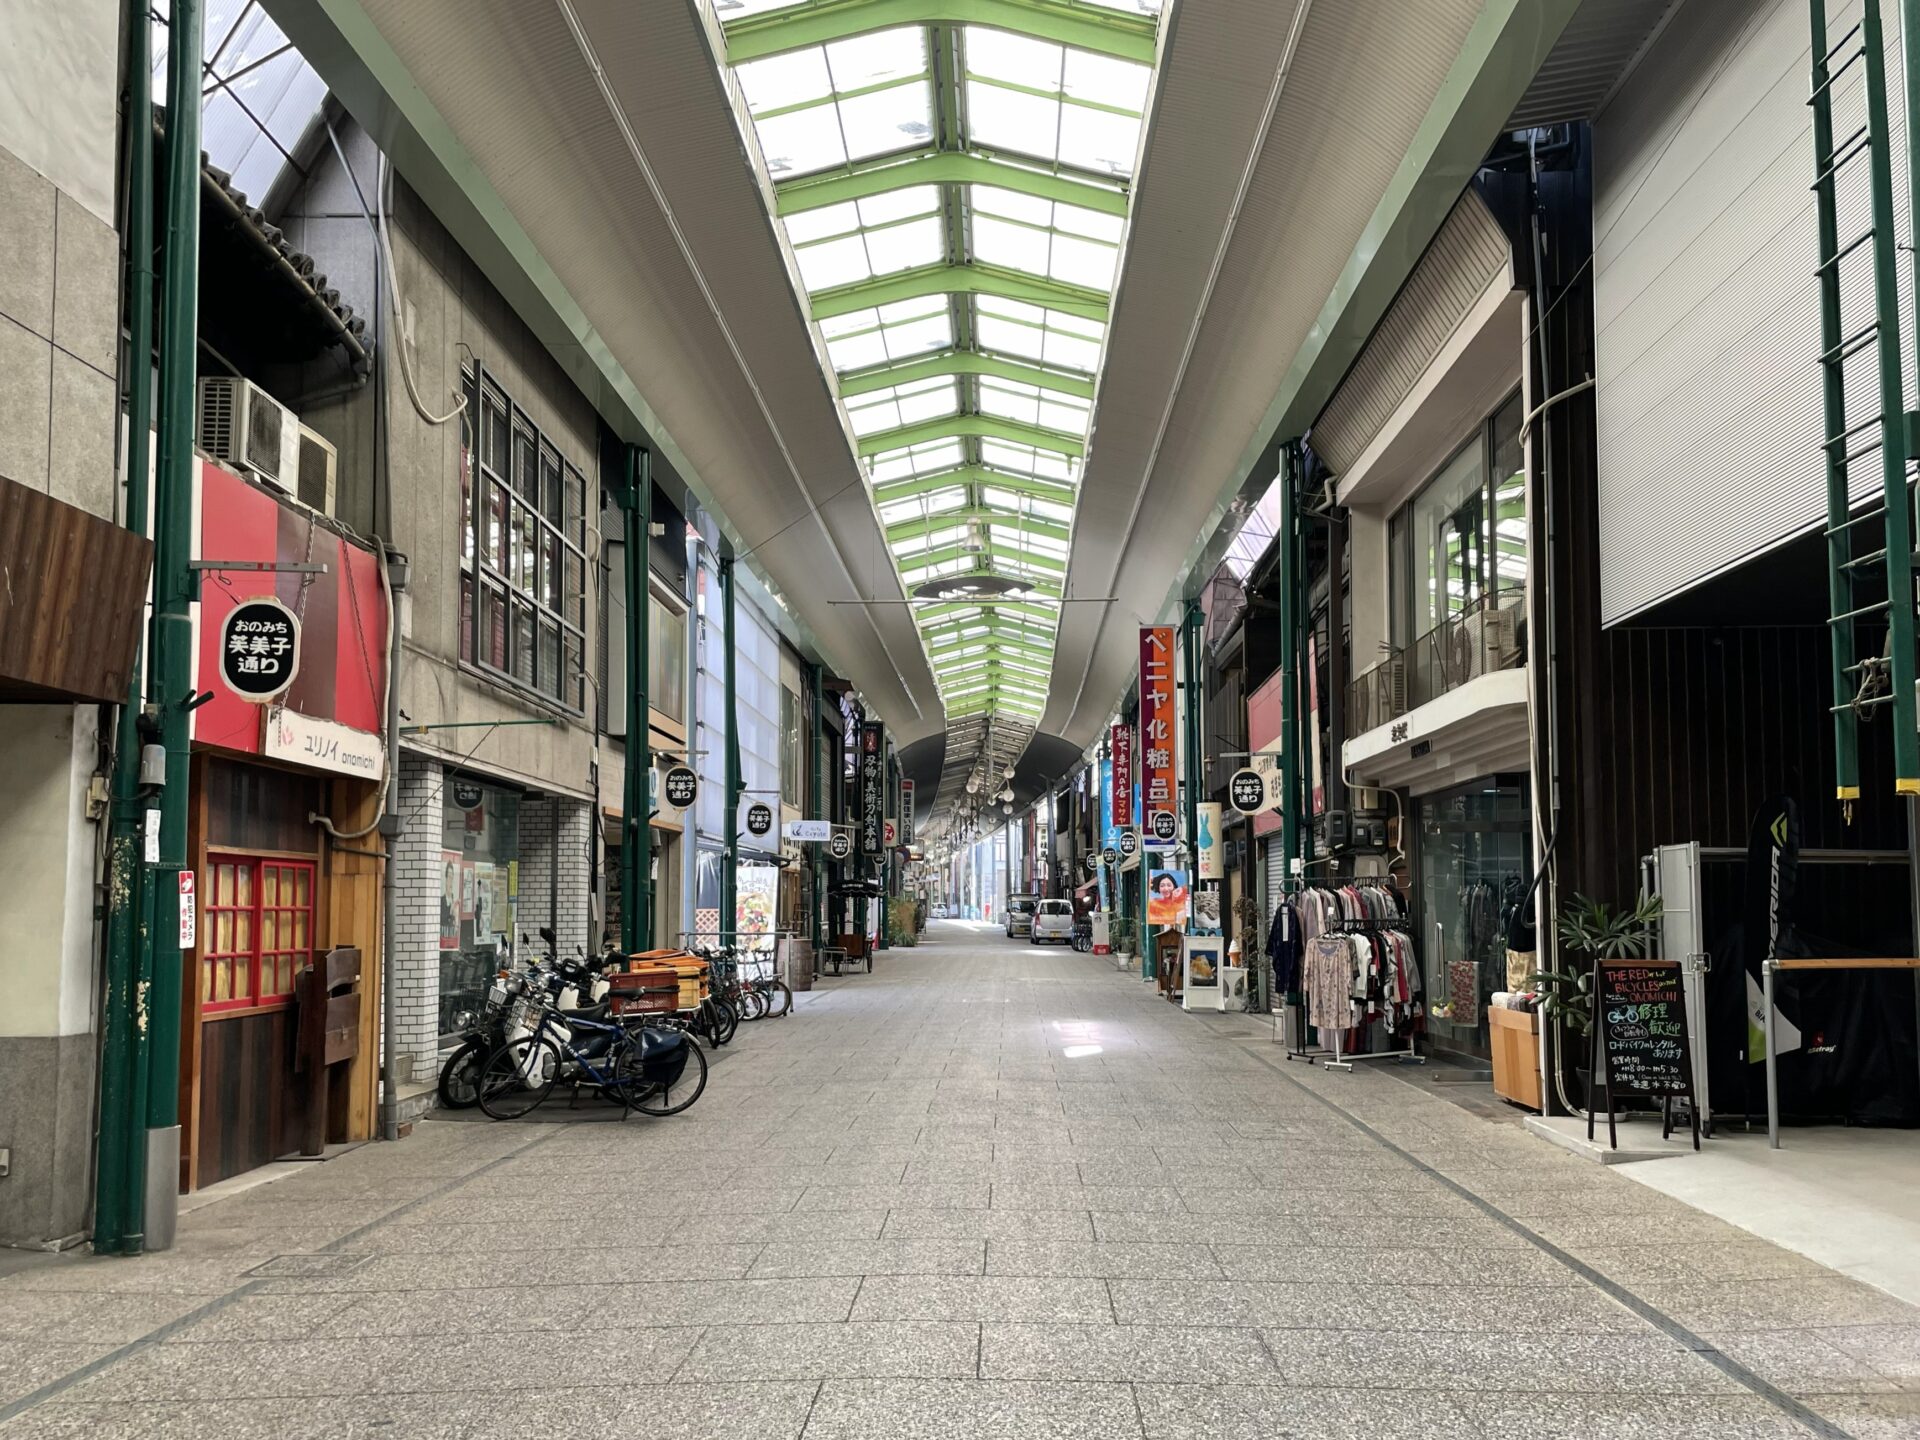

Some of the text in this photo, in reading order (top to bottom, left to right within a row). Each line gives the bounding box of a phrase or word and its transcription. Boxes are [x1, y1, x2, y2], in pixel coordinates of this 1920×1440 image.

[234, 620, 288, 634] おのみち
[228, 634, 292, 656] 芙美子
[237, 656, 280, 674] 通り
[304, 735, 375, 770] ユリノイ onomichi
[1238, 794, 1258, 803] 通り
[1606, 970, 1627, 982] THE
[1628, 969, 1649, 980] RED
[1614, 981, 1660, 993] BICYCLES
[1629, 991, 1677, 1003] ONOMICHI
[1638, 1003, 1669, 1020] 修理
[1648, 1020, 1681, 1037] 歓迎
[1652, 1048, 1683, 1059] あります
